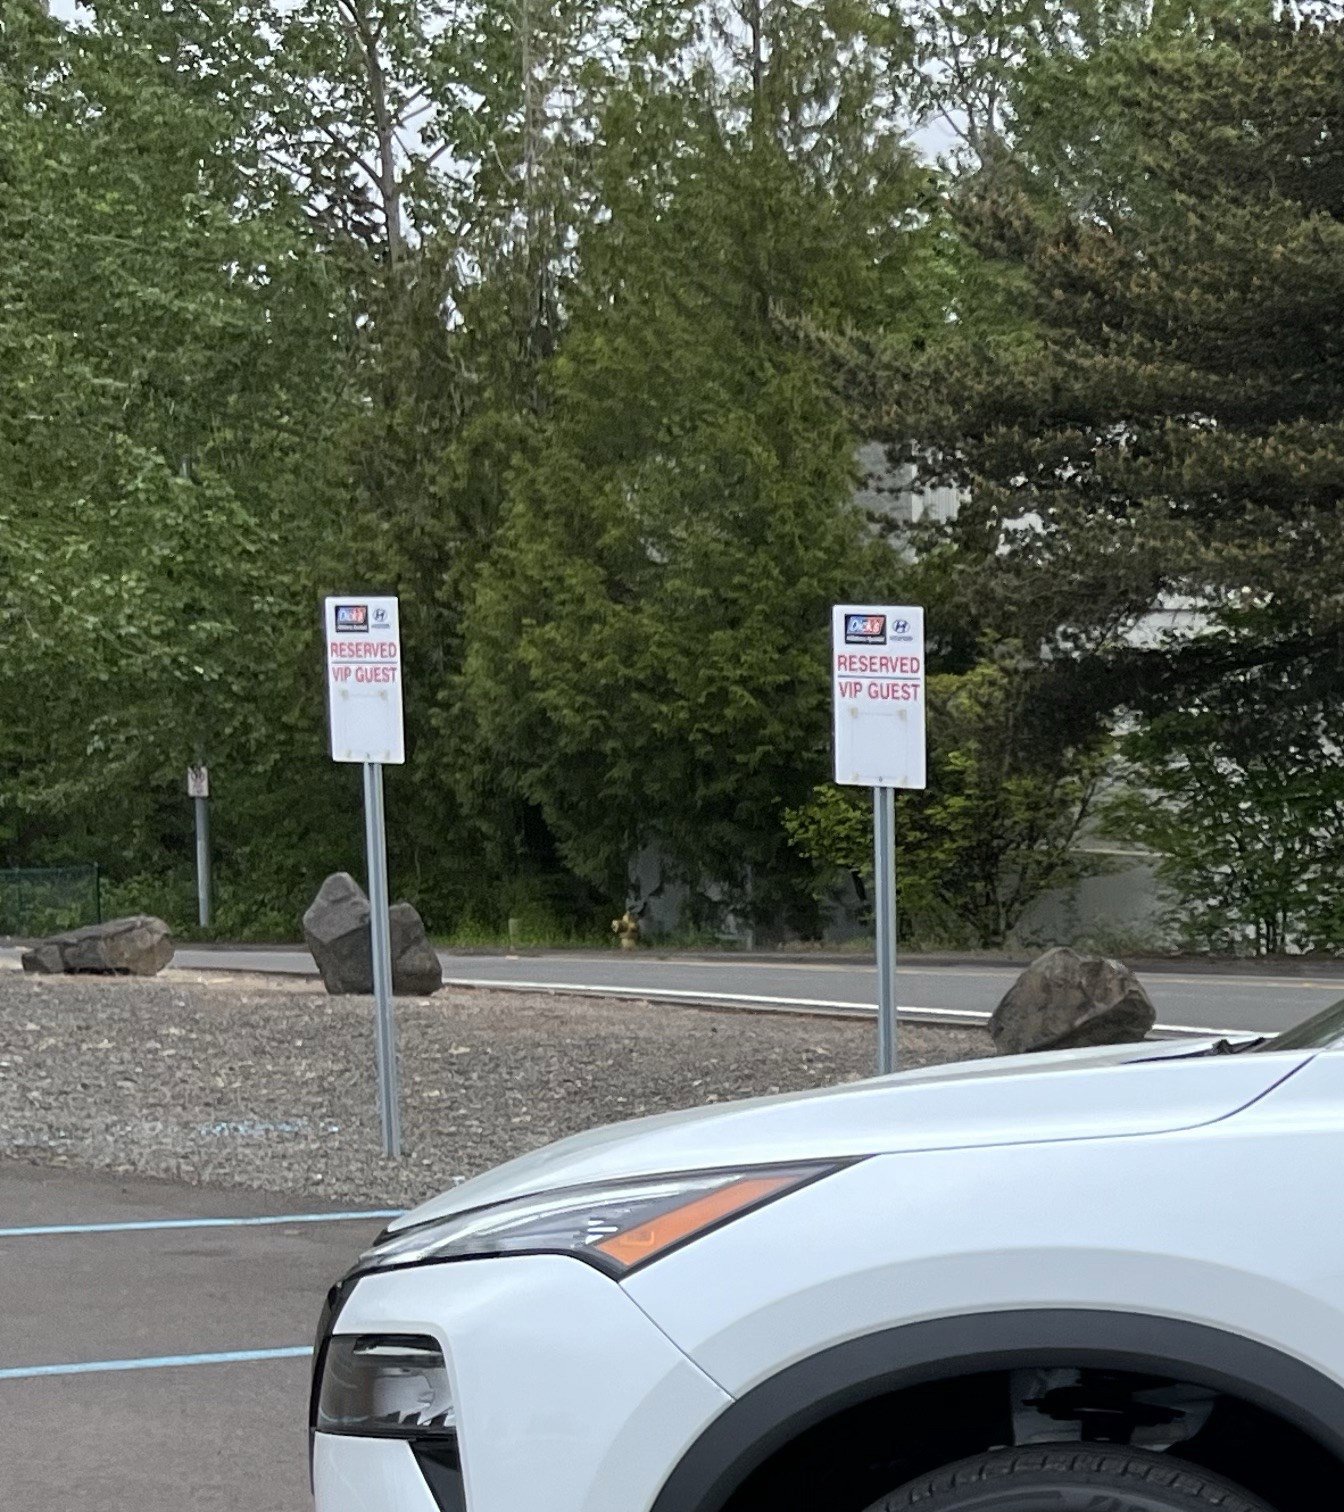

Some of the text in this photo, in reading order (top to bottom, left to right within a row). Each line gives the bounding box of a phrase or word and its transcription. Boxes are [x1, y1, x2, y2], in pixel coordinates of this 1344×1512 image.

[330, 642, 397, 659] RESERVED
[837, 655, 920, 674] RESERVED
[332, 666, 397, 684] VIP GUEST
[838, 681, 920, 701] VIP GUEST
